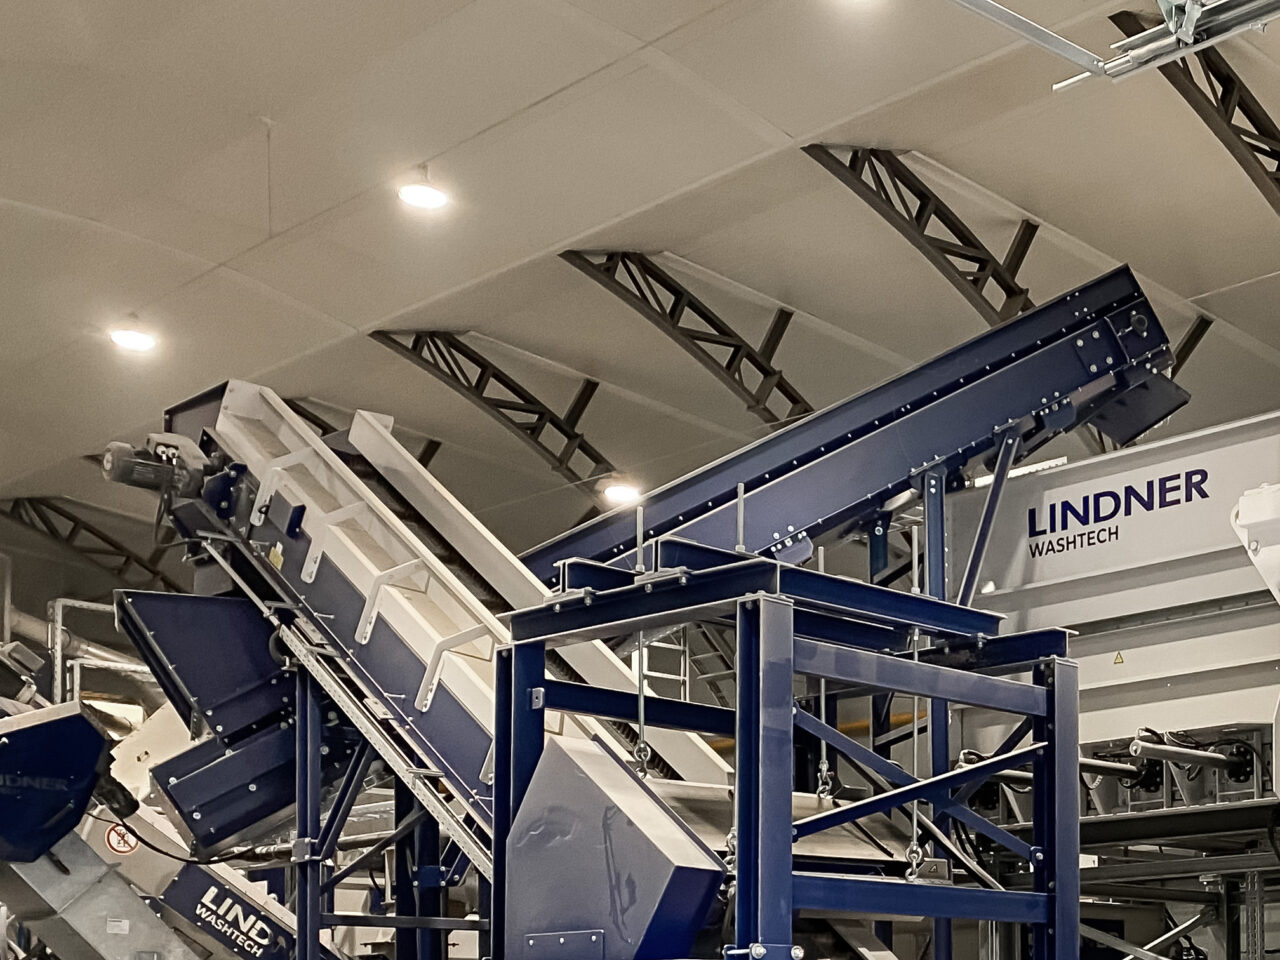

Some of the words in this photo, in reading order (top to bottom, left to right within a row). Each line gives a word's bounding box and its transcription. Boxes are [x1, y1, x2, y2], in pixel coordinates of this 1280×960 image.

[1027, 468, 1210, 538] LINDNER
[1028, 525, 1120, 559] WASHTECH
[195, 903, 264, 958] WASHTECH
